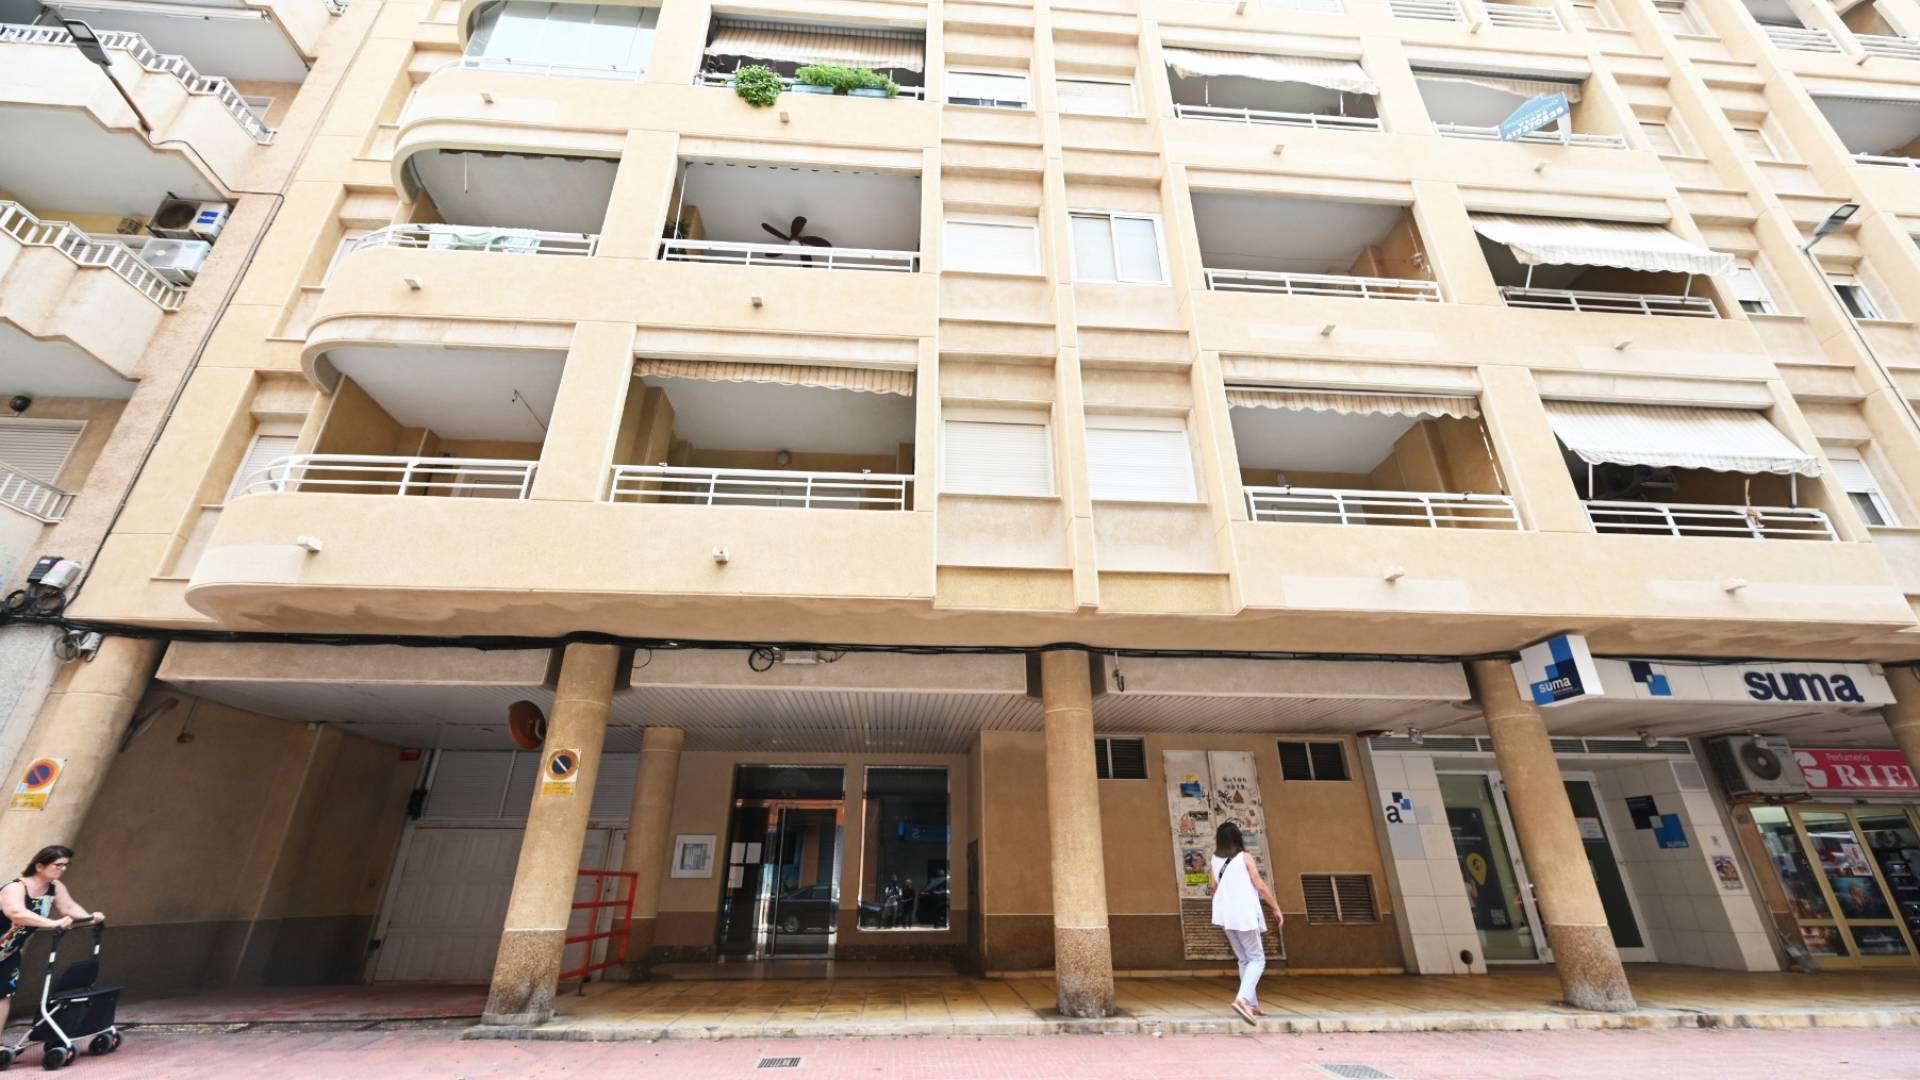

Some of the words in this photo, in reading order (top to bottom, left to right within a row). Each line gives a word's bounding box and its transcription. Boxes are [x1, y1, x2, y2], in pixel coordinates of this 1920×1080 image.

[1538, 676, 1572, 694] suma
[1744, 671, 1865, 702] suma
[1385, 805, 1403, 823] a
